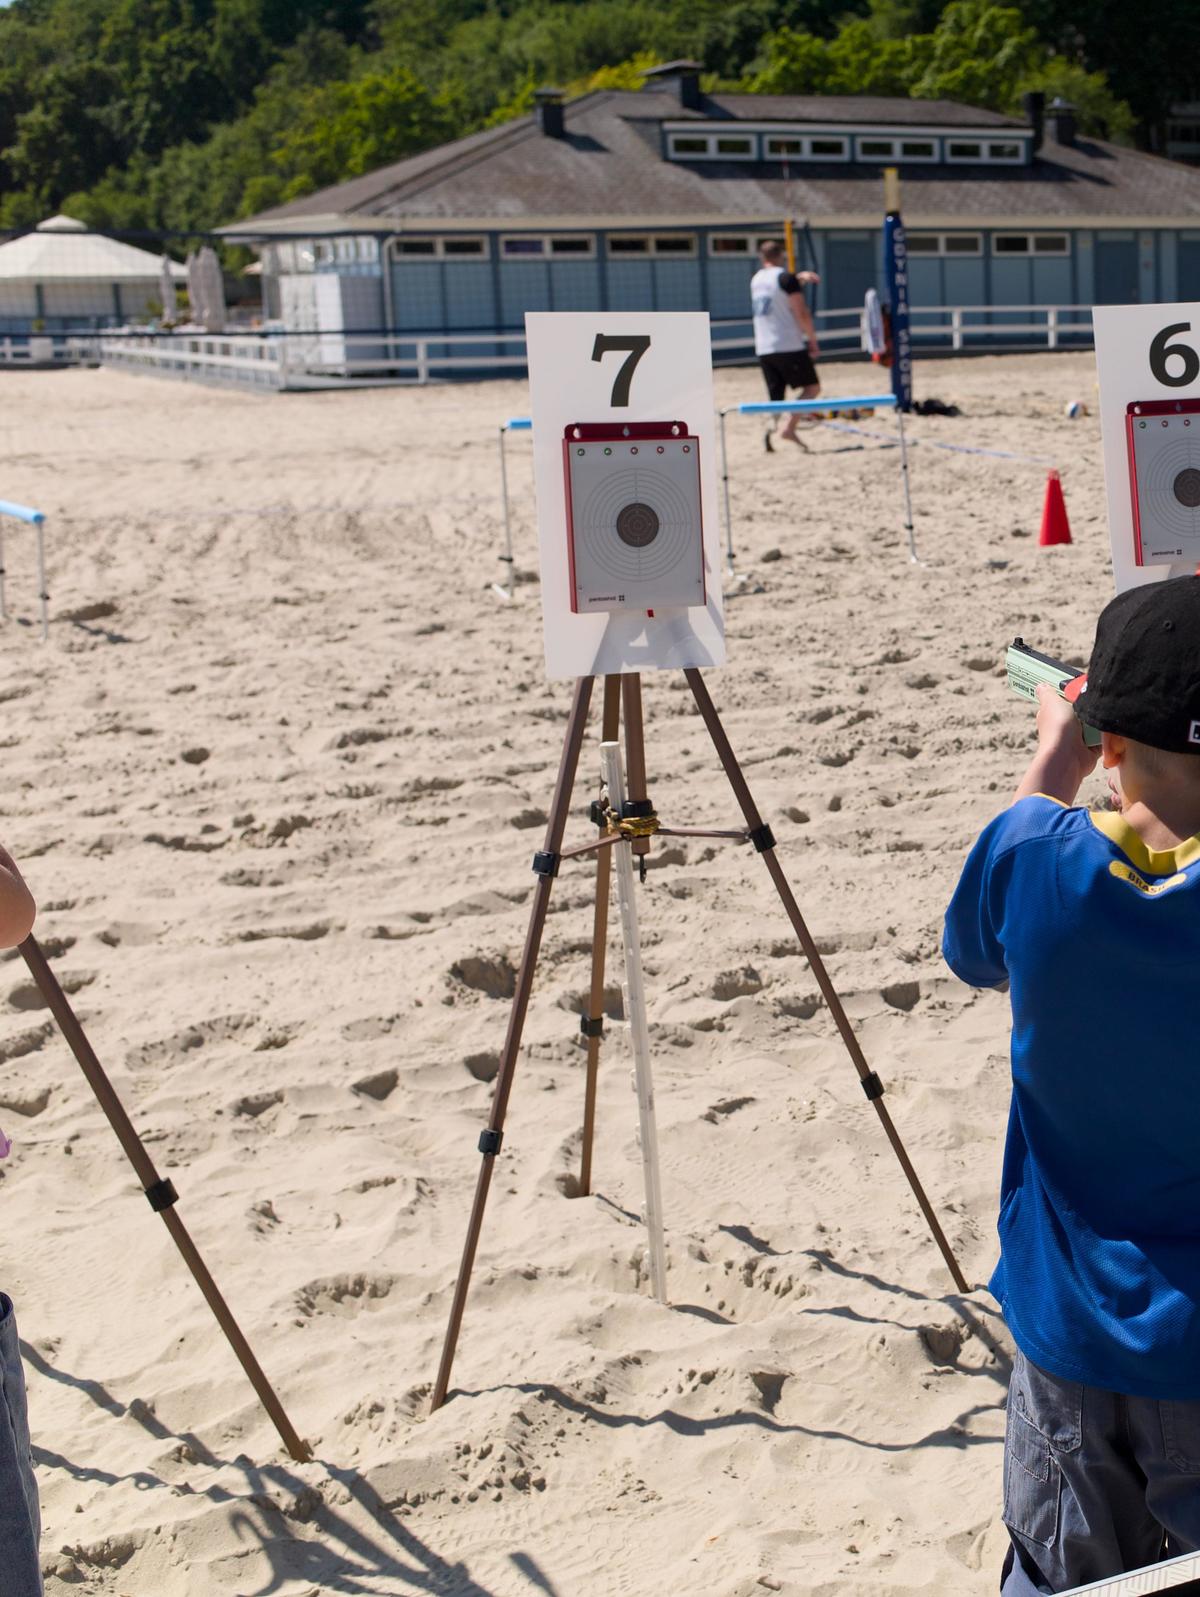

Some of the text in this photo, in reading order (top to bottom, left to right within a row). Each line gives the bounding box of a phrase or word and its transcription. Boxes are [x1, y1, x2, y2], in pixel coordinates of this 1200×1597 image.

[893, 227, 909, 315] GDYNIA
[591, 333, 651, 408] 7
[1148, 321, 1200, 388] 6
